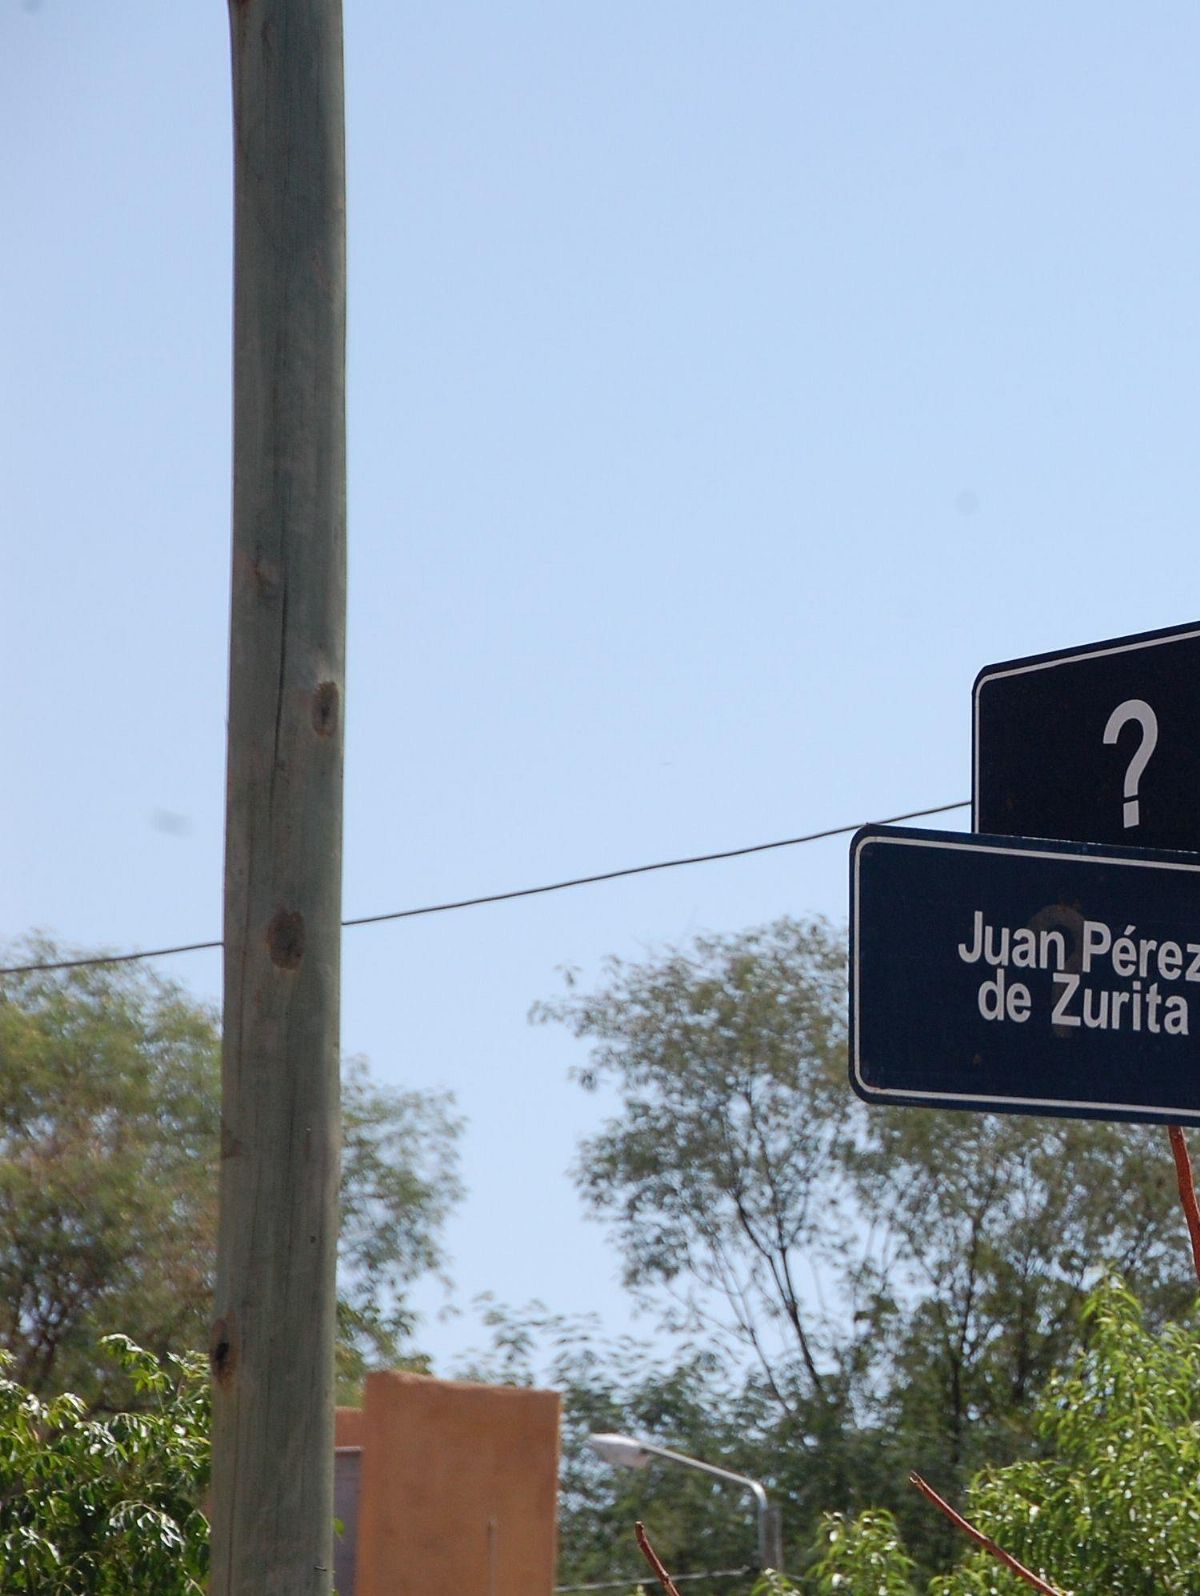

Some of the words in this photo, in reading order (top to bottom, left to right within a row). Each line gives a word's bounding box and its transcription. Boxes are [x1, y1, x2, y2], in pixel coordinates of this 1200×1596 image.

[1102, 699, 1158, 828] ?
[958, 910, 1065, 971] Juan
[978, 968, 1032, 1023] de
[1051, 972, 1189, 1035] Zurita
